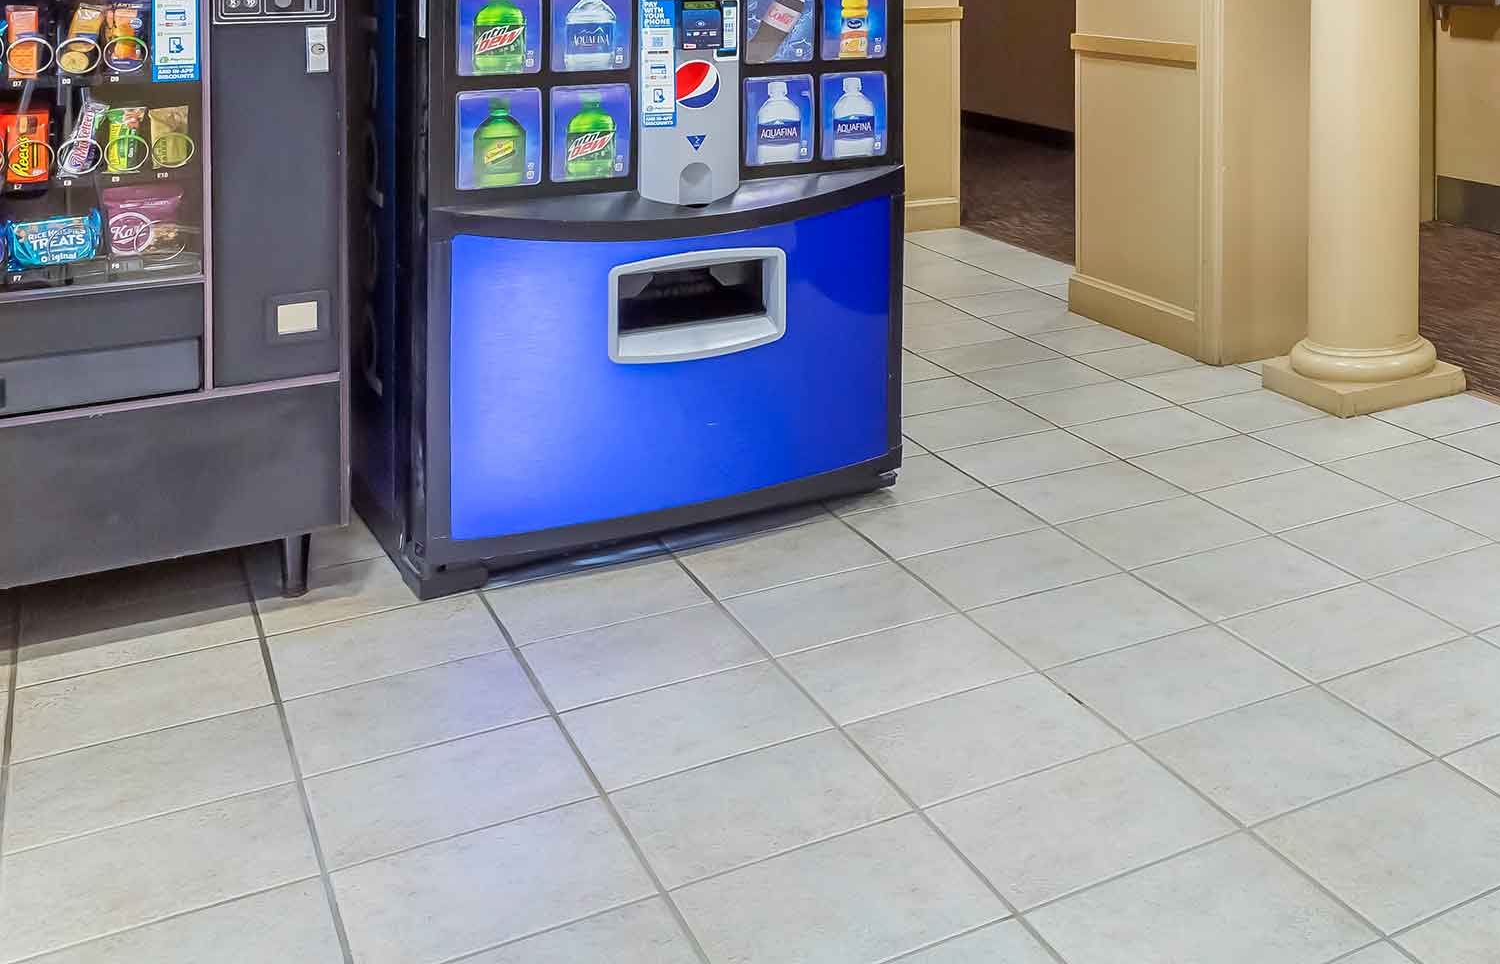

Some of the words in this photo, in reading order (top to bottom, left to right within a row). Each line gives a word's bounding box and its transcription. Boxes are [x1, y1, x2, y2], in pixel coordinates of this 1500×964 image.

[573, 36, 610, 46] AQUAFINA
[761, 127, 798, 139] AQUAFINA
[837, 122, 872, 134] AQUAFINA
[28, 231, 47, 240] RICE
[31, 234, 86, 251] TREATS
